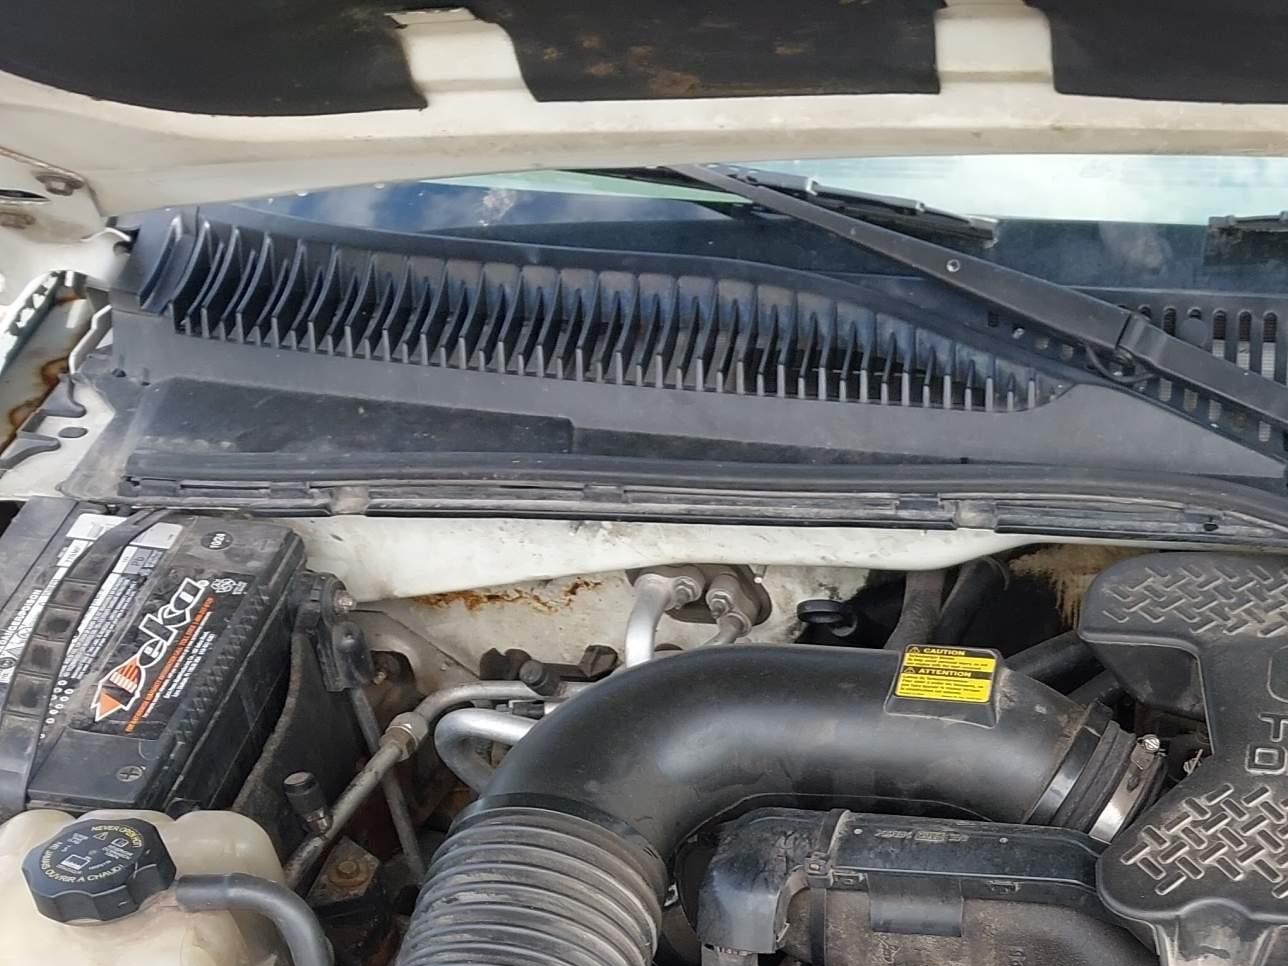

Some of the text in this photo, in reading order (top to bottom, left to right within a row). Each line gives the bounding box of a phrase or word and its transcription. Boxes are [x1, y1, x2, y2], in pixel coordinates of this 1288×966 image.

[923, 647, 966, 656] CAUTION
[918, 668, 972, 678] ATTENTION
[45, 869, 76, 883] OUVRIR
